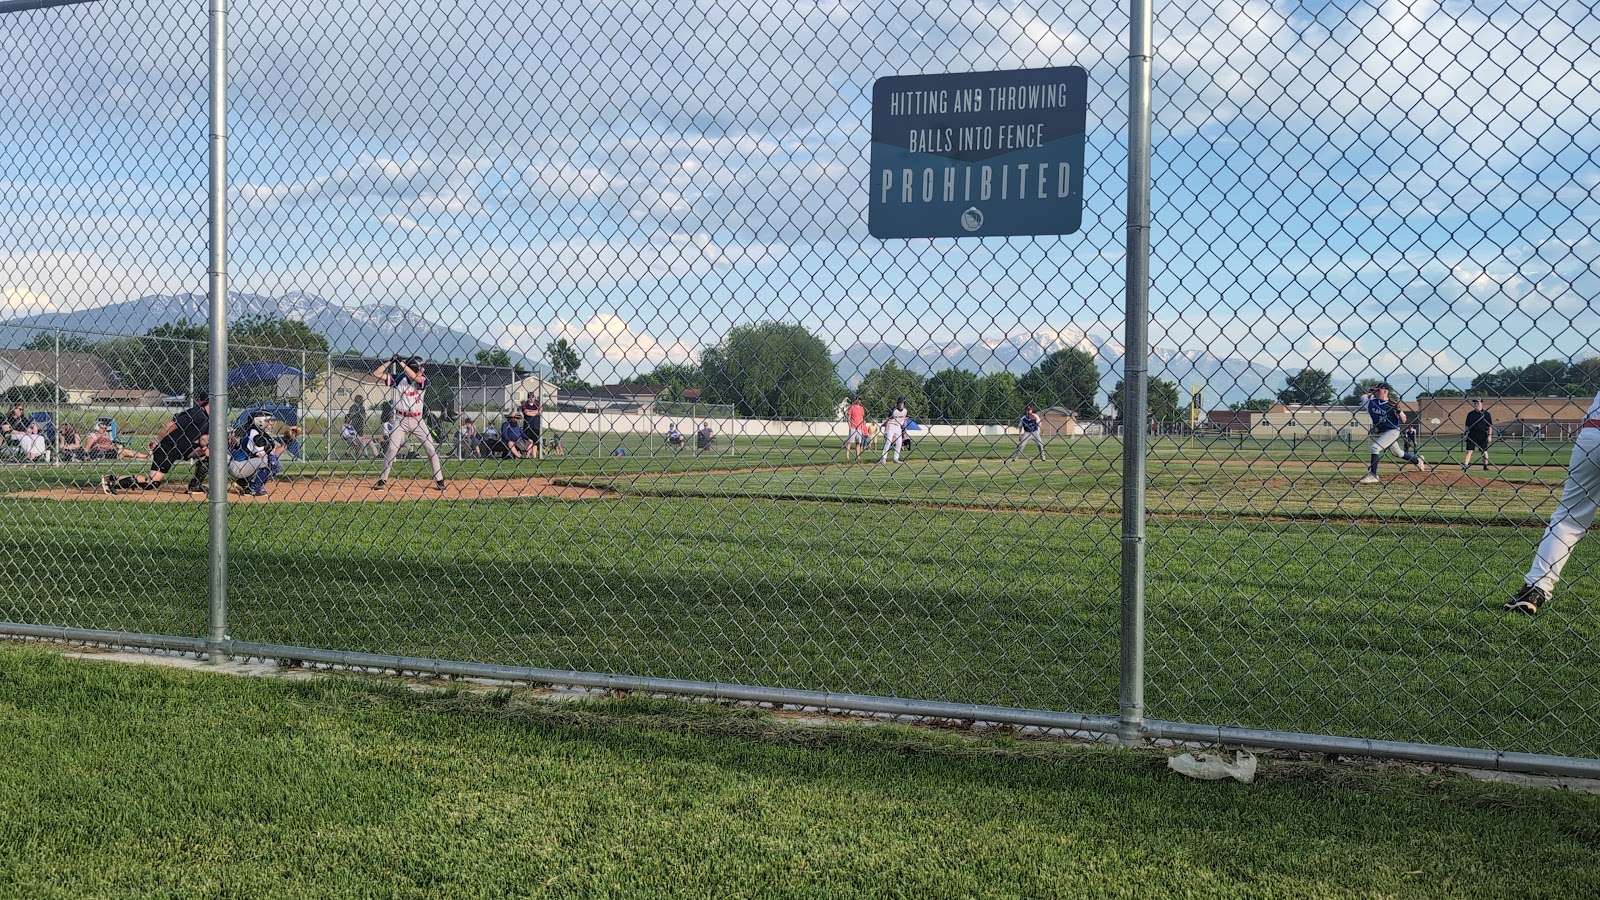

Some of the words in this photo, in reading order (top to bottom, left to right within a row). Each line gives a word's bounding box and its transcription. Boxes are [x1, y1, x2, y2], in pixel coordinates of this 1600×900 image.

[890, 89, 948, 116] HITTING
[953, 88, 983, 113] AND
[989, 83, 1067, 112] THROWING
[909, 127, 953, 153] BALLS
[958, 125, 992, 151] INTO
[998, 123, 1044, 150] FENCE
[881, 161, 1071, 204] PROHIBITED
